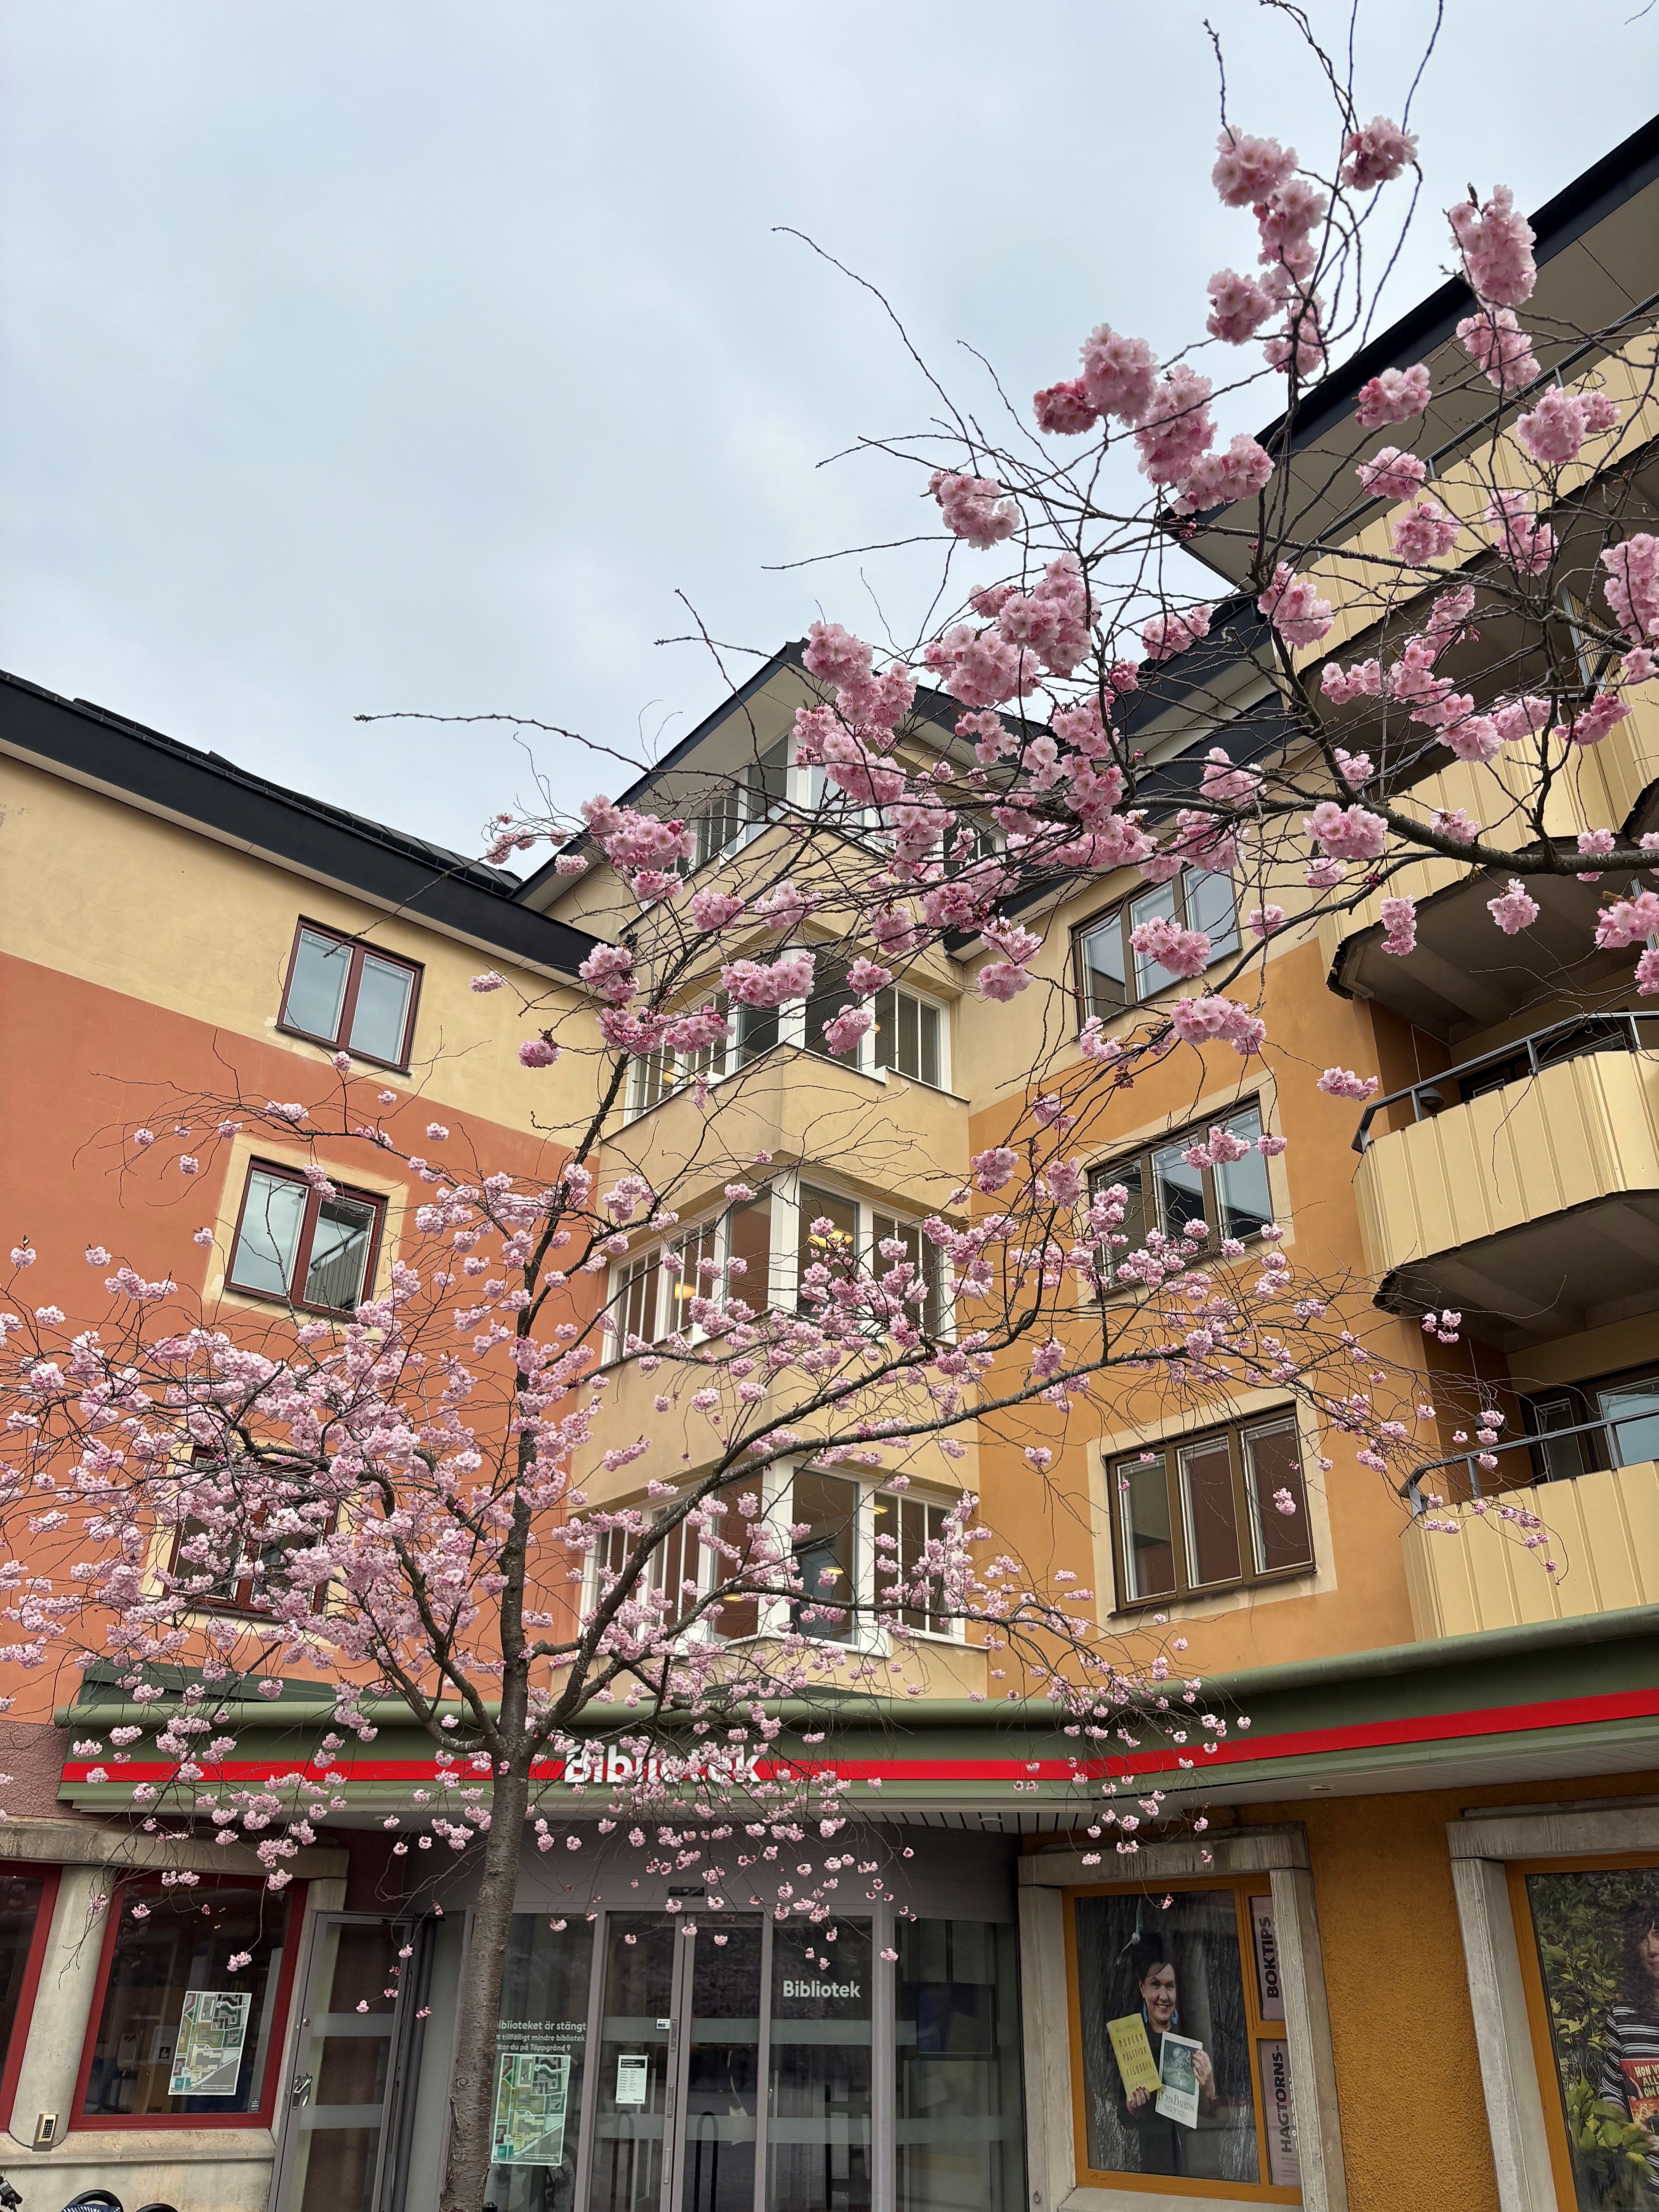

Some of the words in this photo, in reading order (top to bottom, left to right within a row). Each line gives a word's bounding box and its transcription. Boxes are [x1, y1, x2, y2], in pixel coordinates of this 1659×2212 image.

[1259, 1917, 1279, 1998] BOKTIPS
[783, 1980, 861, 1997] Bibliotek
[498, 2020, 543, 2030] iblioteket
[544, 2021, 555, 2030] är
[556, 2021, 587, 2032] stängt
[520, 2043, 529, 2051] på
[530, 2044, 565, 2052] Täppgränd
[1635, 2065, 1651, 2077] HON
[1644, 2087, 1656, 2097] OM
[1272, 2045, 1292, 2153] HAGTORNS-
